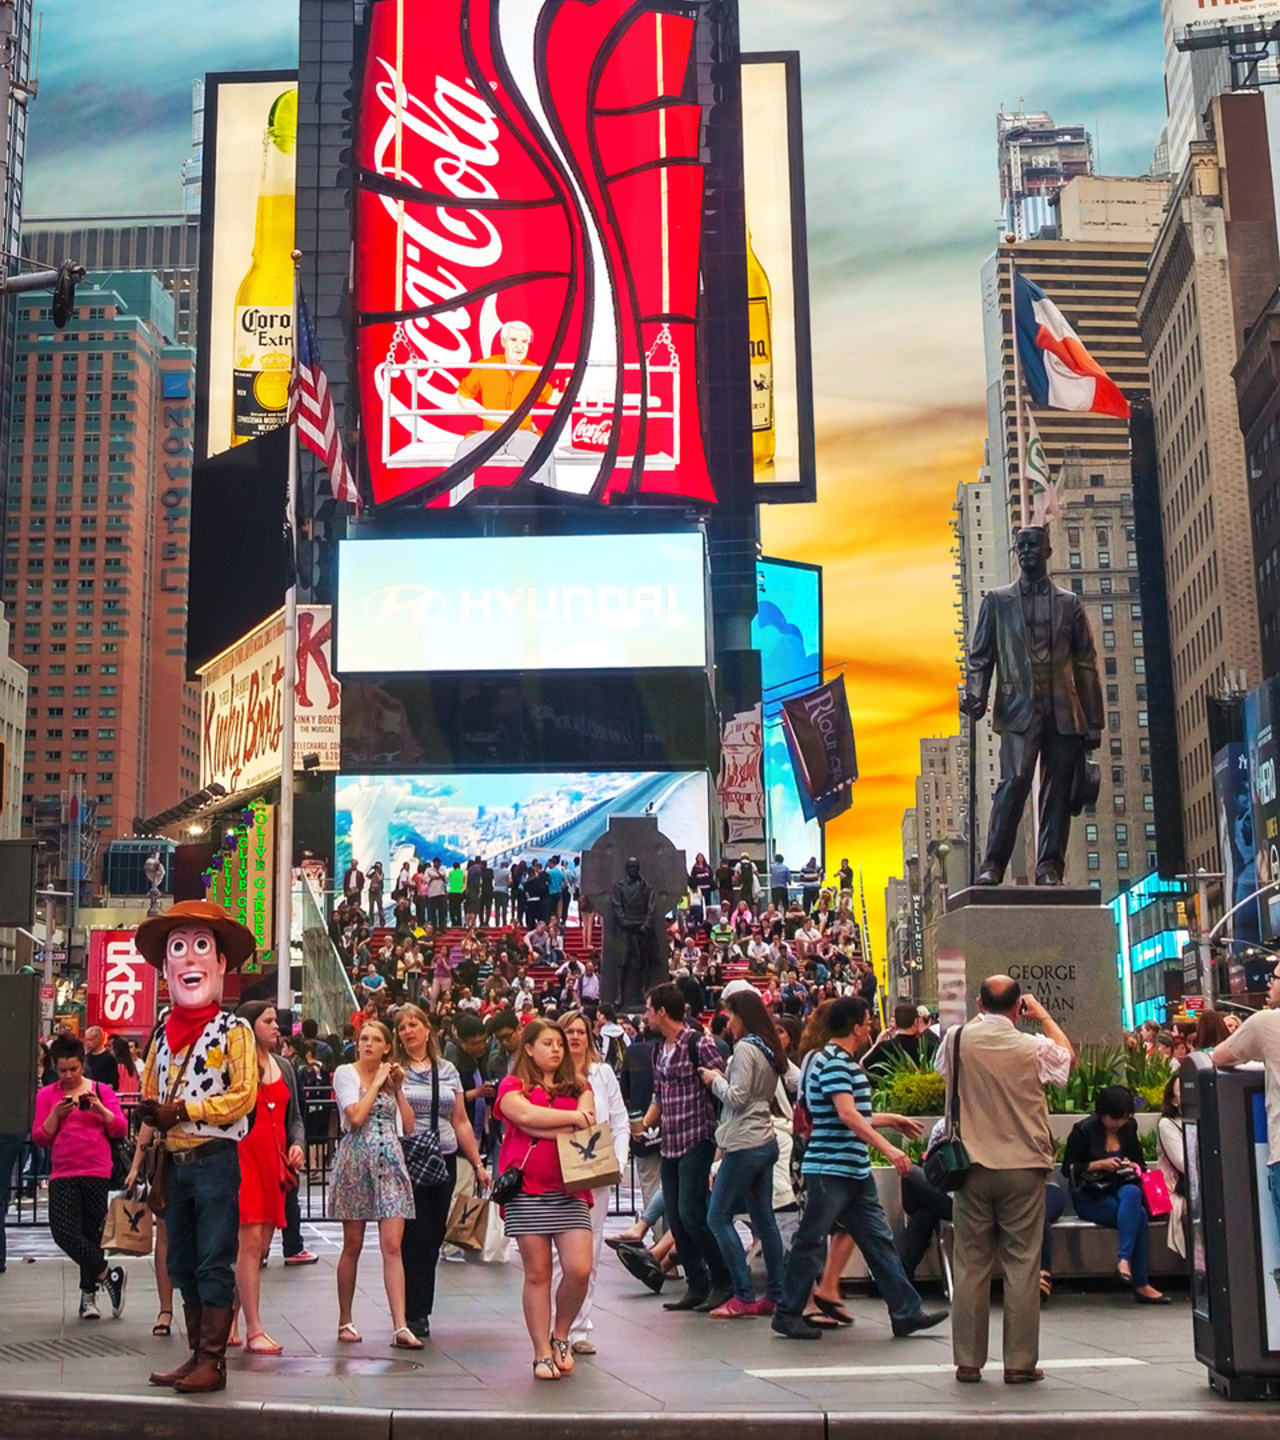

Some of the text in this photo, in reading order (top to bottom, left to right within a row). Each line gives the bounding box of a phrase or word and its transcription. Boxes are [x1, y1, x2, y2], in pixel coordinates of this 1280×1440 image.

[160, 405, 183, 593] NOVOTEL
[461, 584, 686, 626] HYUNDAI
[253, 812, 268, 947] OLIVE GARDEN
[912, 895, 924, 971] WELLINGTON
[1008, 964, 1077, 980] GEORGE
[104, 938, 146, 1022] tkts
